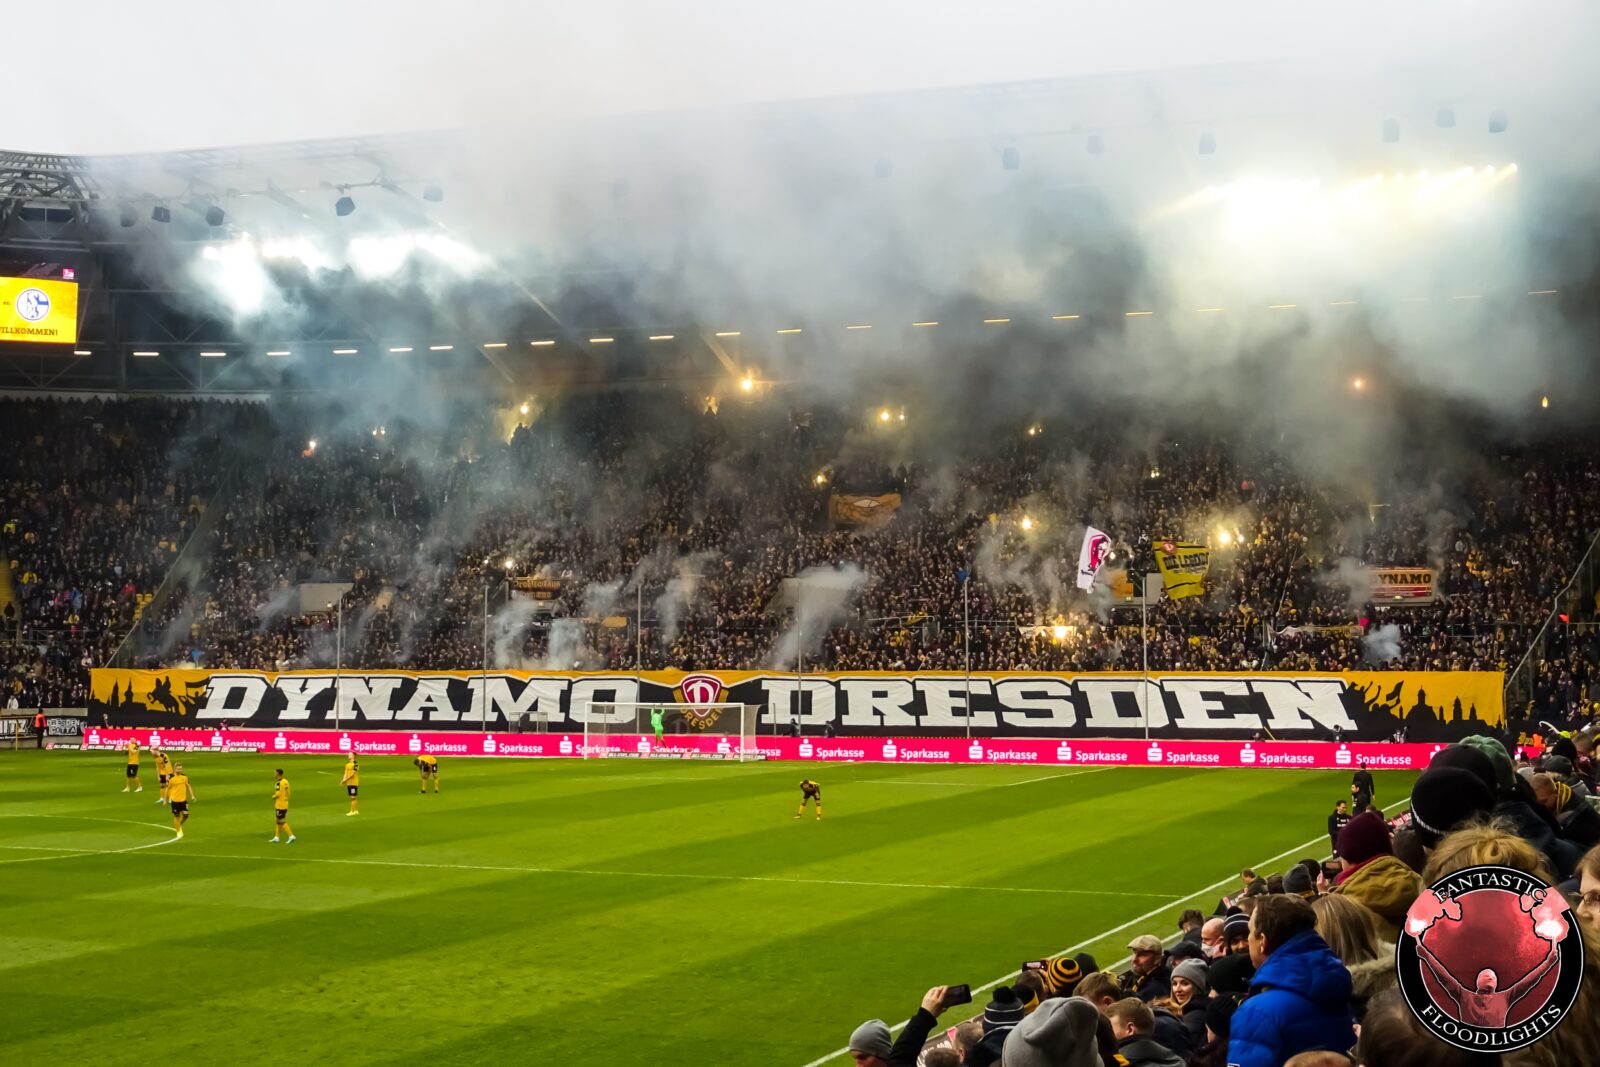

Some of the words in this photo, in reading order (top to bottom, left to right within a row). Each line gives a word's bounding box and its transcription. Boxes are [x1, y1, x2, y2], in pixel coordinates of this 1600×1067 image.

[0, 327, 58, 335] ILLKOMMEN!
[195, 675, 637, 723] DYNAMO
[760, 678, 1358, 731] DRESDEN
[102, 738, 141, 746] Sparkase
[163, 739, 203, 747] Sparkasse
[225, 740, 267, 749] Sparkasse
[289, 741, 331, 751] Sparkasse
[354, 742, 397, 752] Sparkasse
[424, 743, 468, 753] Sparkasse
[499, 744, 543, 754] Sparkasse
[575, 745, 621, 754] Sparkasse
[816, 748, 865, 759] Sparkasse
[900, 749, 950, 760] Sparkasse
[987, 750, 1038, 761] Sparkasse
[1075, 751, 1128, 763] Sparkasse
[1166, 752, 1220, 764] Sparkasse
[1259, 753, 1315, 765] Sparkasse
[1355, 754, 1412, 765] Sparkasse
